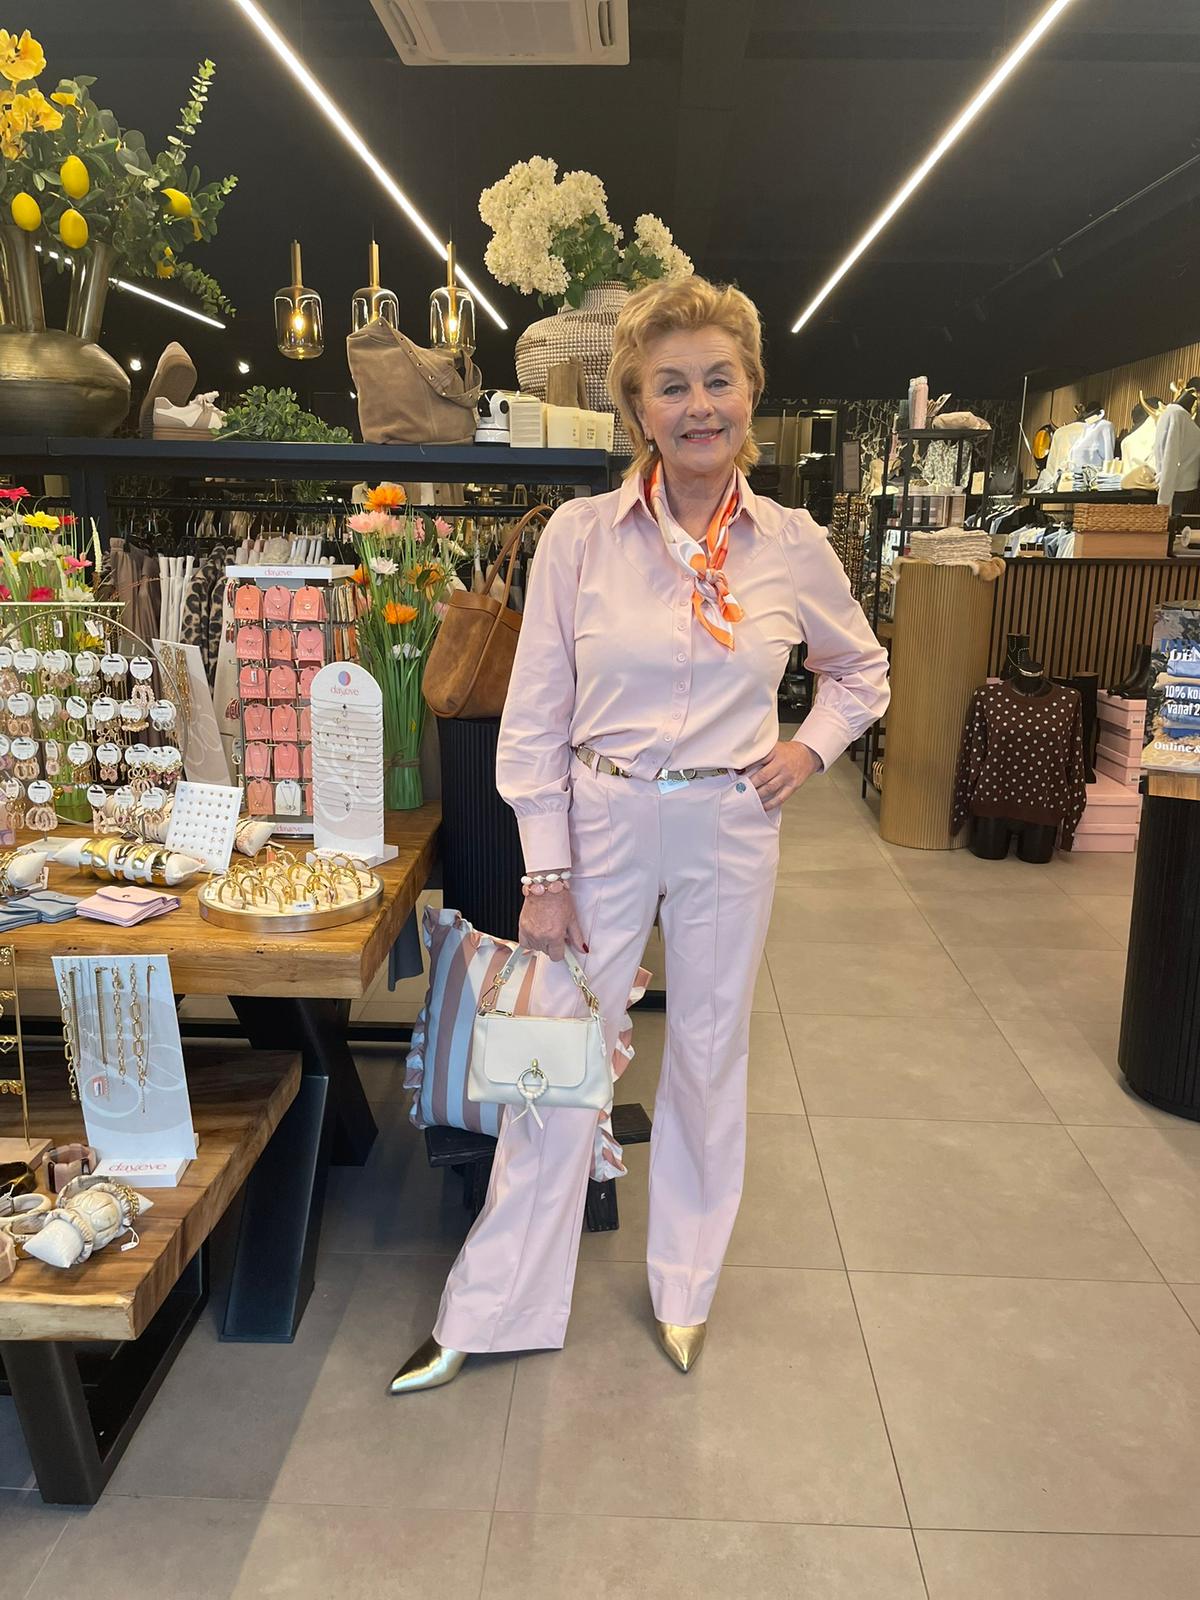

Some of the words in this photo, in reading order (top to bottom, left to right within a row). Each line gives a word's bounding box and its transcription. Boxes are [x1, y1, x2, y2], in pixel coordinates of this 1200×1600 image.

[1165, 685, 1186, 699] 10%
[1167, 702, 1193, 716] vanaf
[1154, 741, 1193, 753] Online
